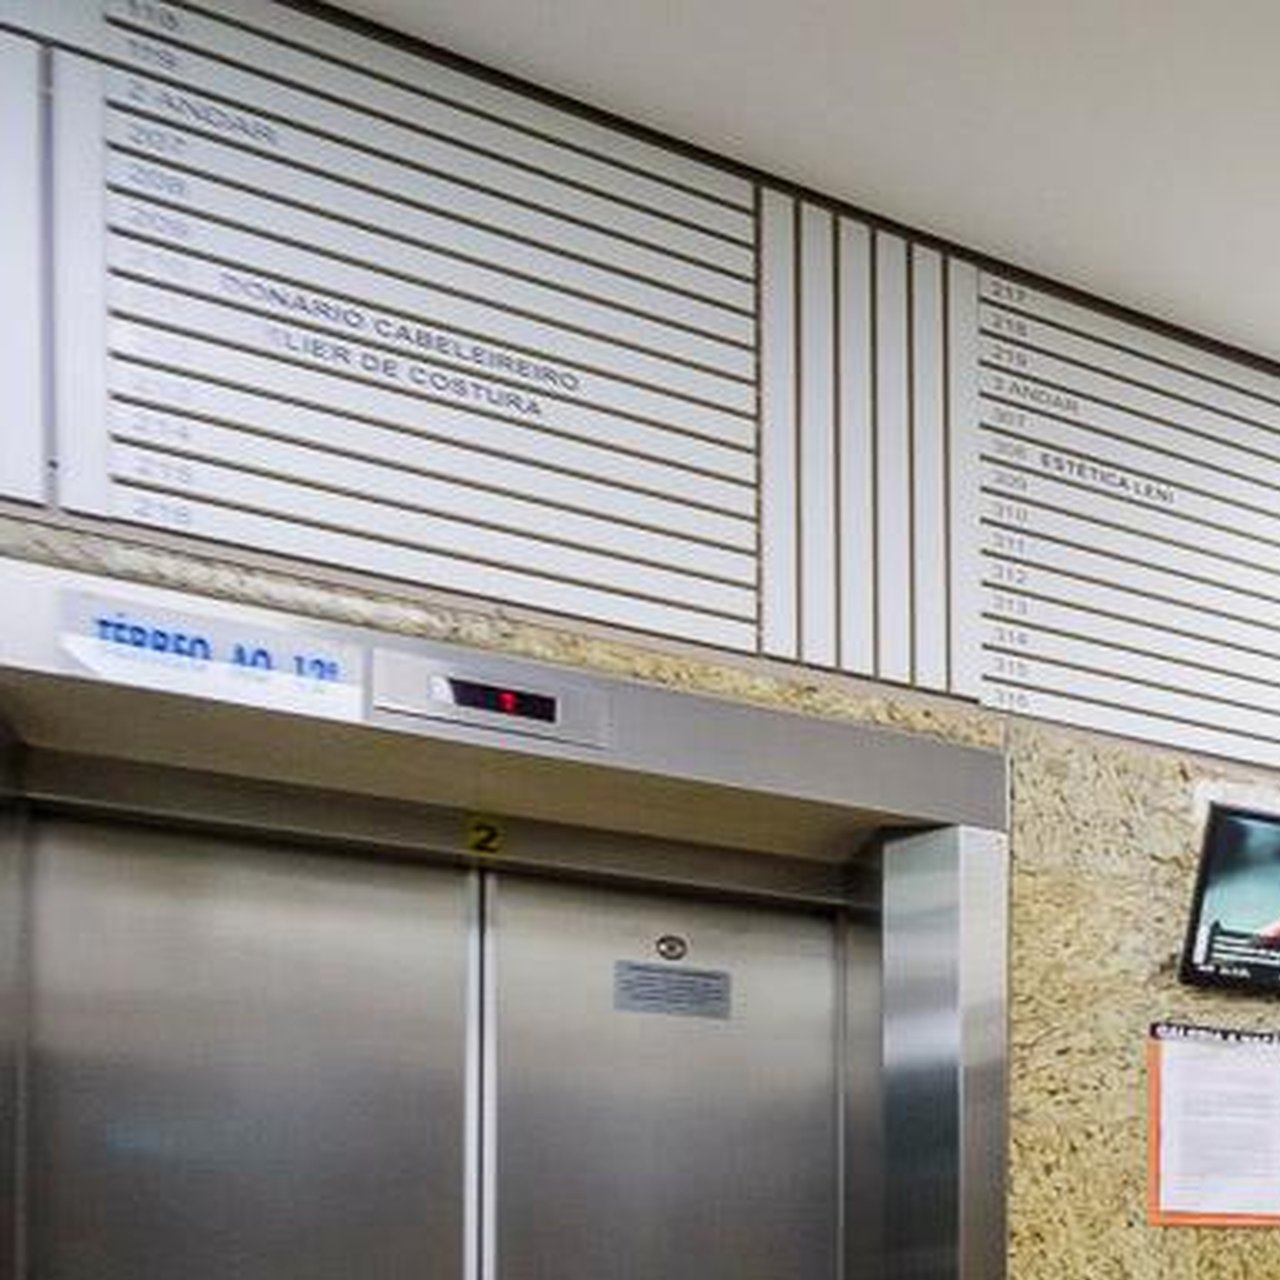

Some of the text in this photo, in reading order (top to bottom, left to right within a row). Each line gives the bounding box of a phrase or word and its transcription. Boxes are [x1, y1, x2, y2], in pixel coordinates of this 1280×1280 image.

[360, 354, 399, 378] DE
[408, 364, 543, 415] COSTURA
[372, 319, 580, 392] CABELEIREIRO
[473, 824, 499, 854] 2
